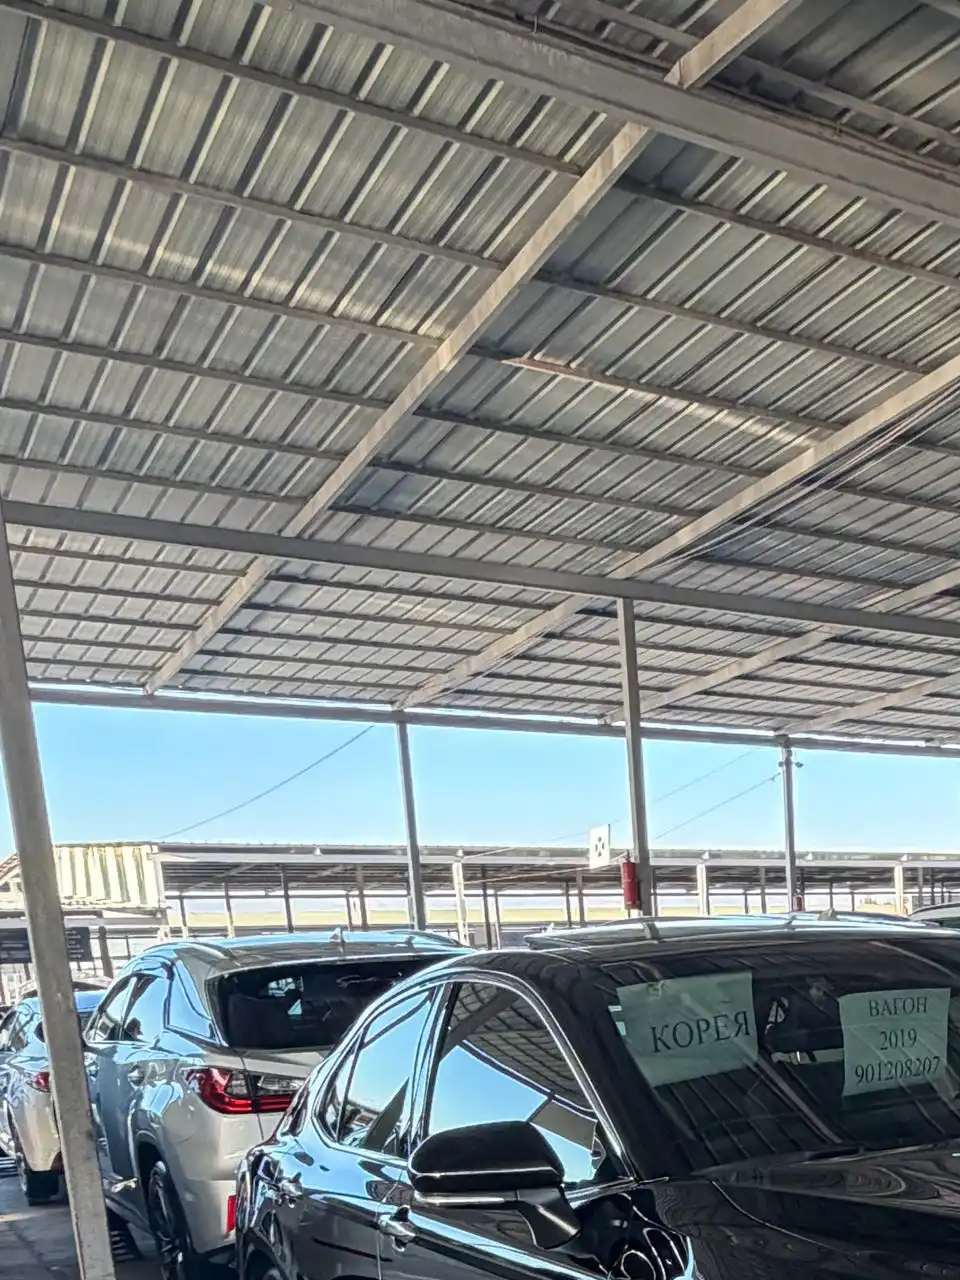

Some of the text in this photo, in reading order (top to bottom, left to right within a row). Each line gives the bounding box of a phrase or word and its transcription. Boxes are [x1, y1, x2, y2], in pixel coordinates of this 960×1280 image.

[868, 996, 928, 1017] ВАГОН
[650, 1009, 751, 1053] КОРЕЯ
[880, 1028, 918, 1051] 2019
[855, 1056, 940, 1086] 901208207
